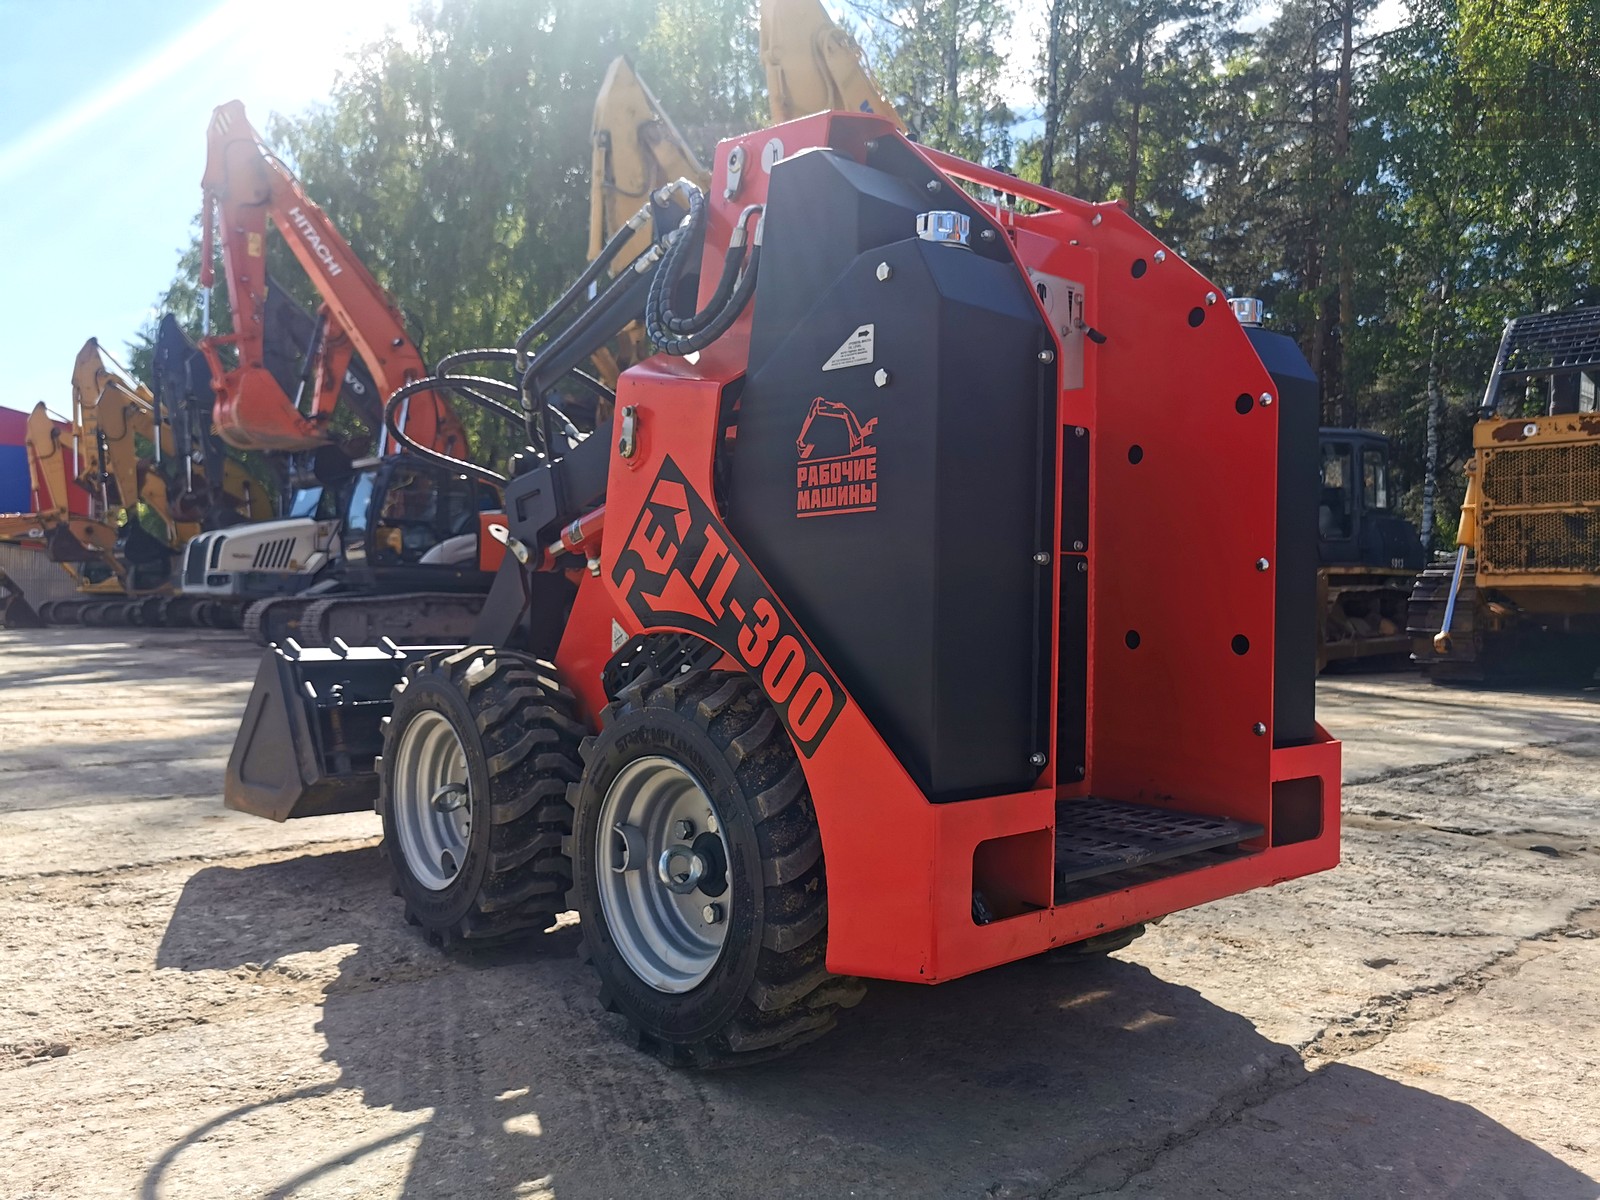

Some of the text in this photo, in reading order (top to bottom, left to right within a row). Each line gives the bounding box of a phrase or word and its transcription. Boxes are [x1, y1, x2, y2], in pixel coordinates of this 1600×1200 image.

[289, 206, 342, 277] HITACHI
[797, 457, 877, 488] РАБОЧИЕ
[797, 482, 877, 511] МАШИНЫ
[690, 523, 833, 742] TL-300
